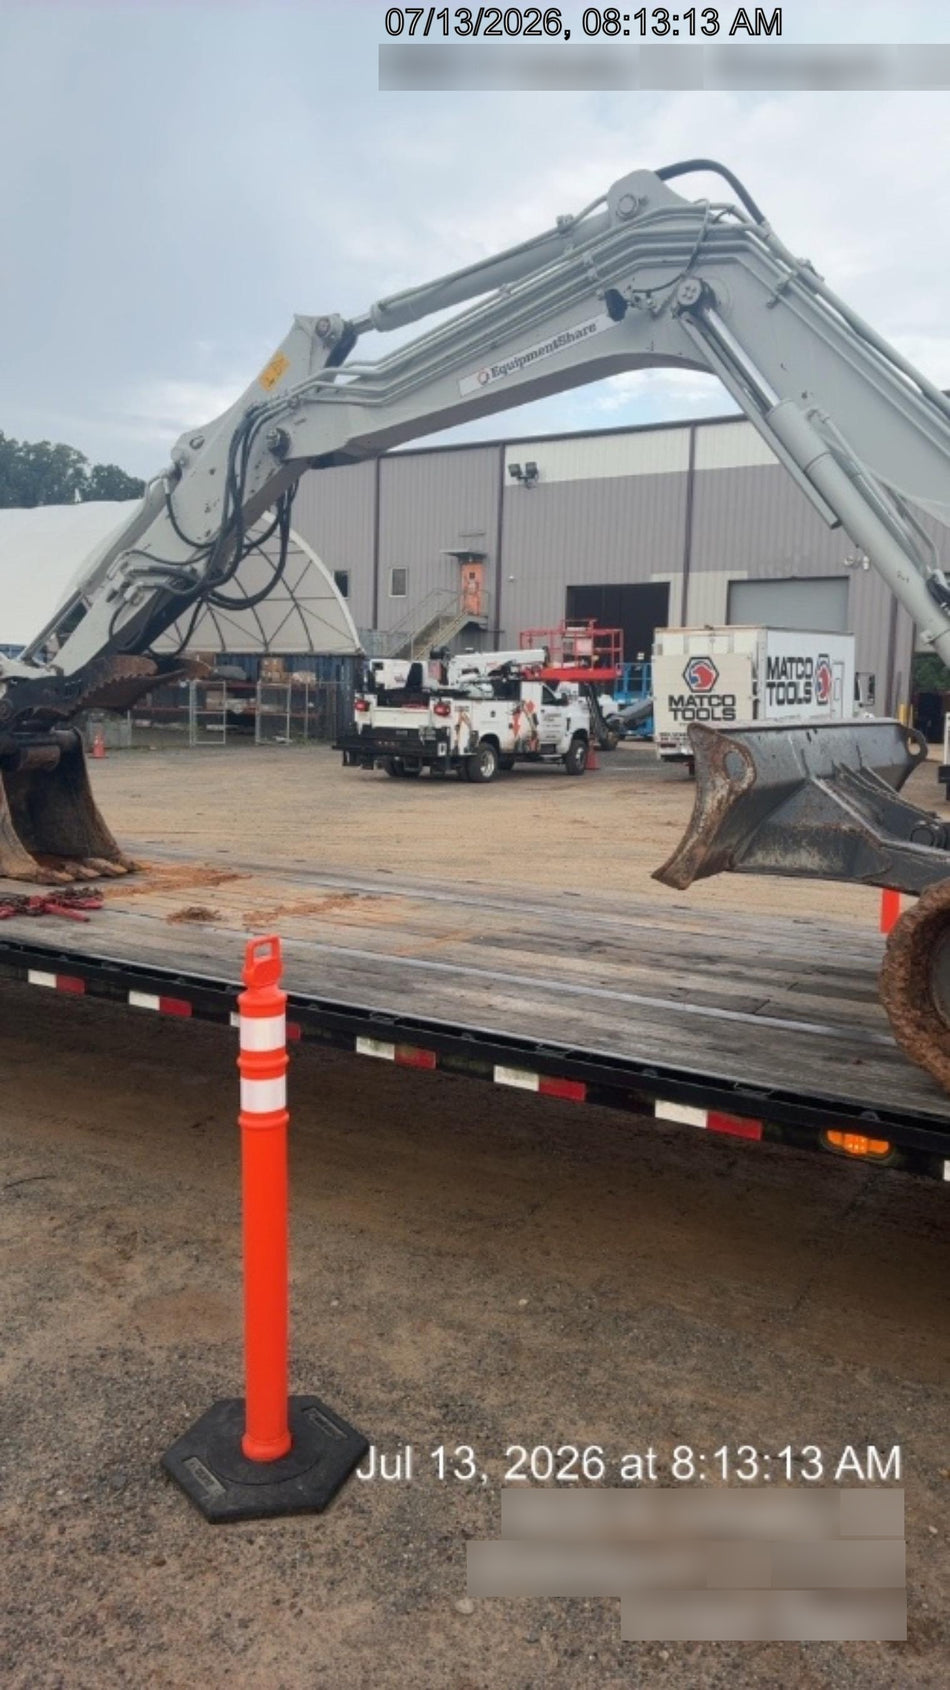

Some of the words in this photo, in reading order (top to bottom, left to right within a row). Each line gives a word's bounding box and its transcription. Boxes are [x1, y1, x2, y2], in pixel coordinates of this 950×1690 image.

[491, 322, 597, 379] EquipmentShare
[767, 656, 814, 680] MATCO
[668, 694, 736, 707] MATCO
[766, 681, 813, 706] TOOLS
[669, 707, 736, 721] TOOLS
